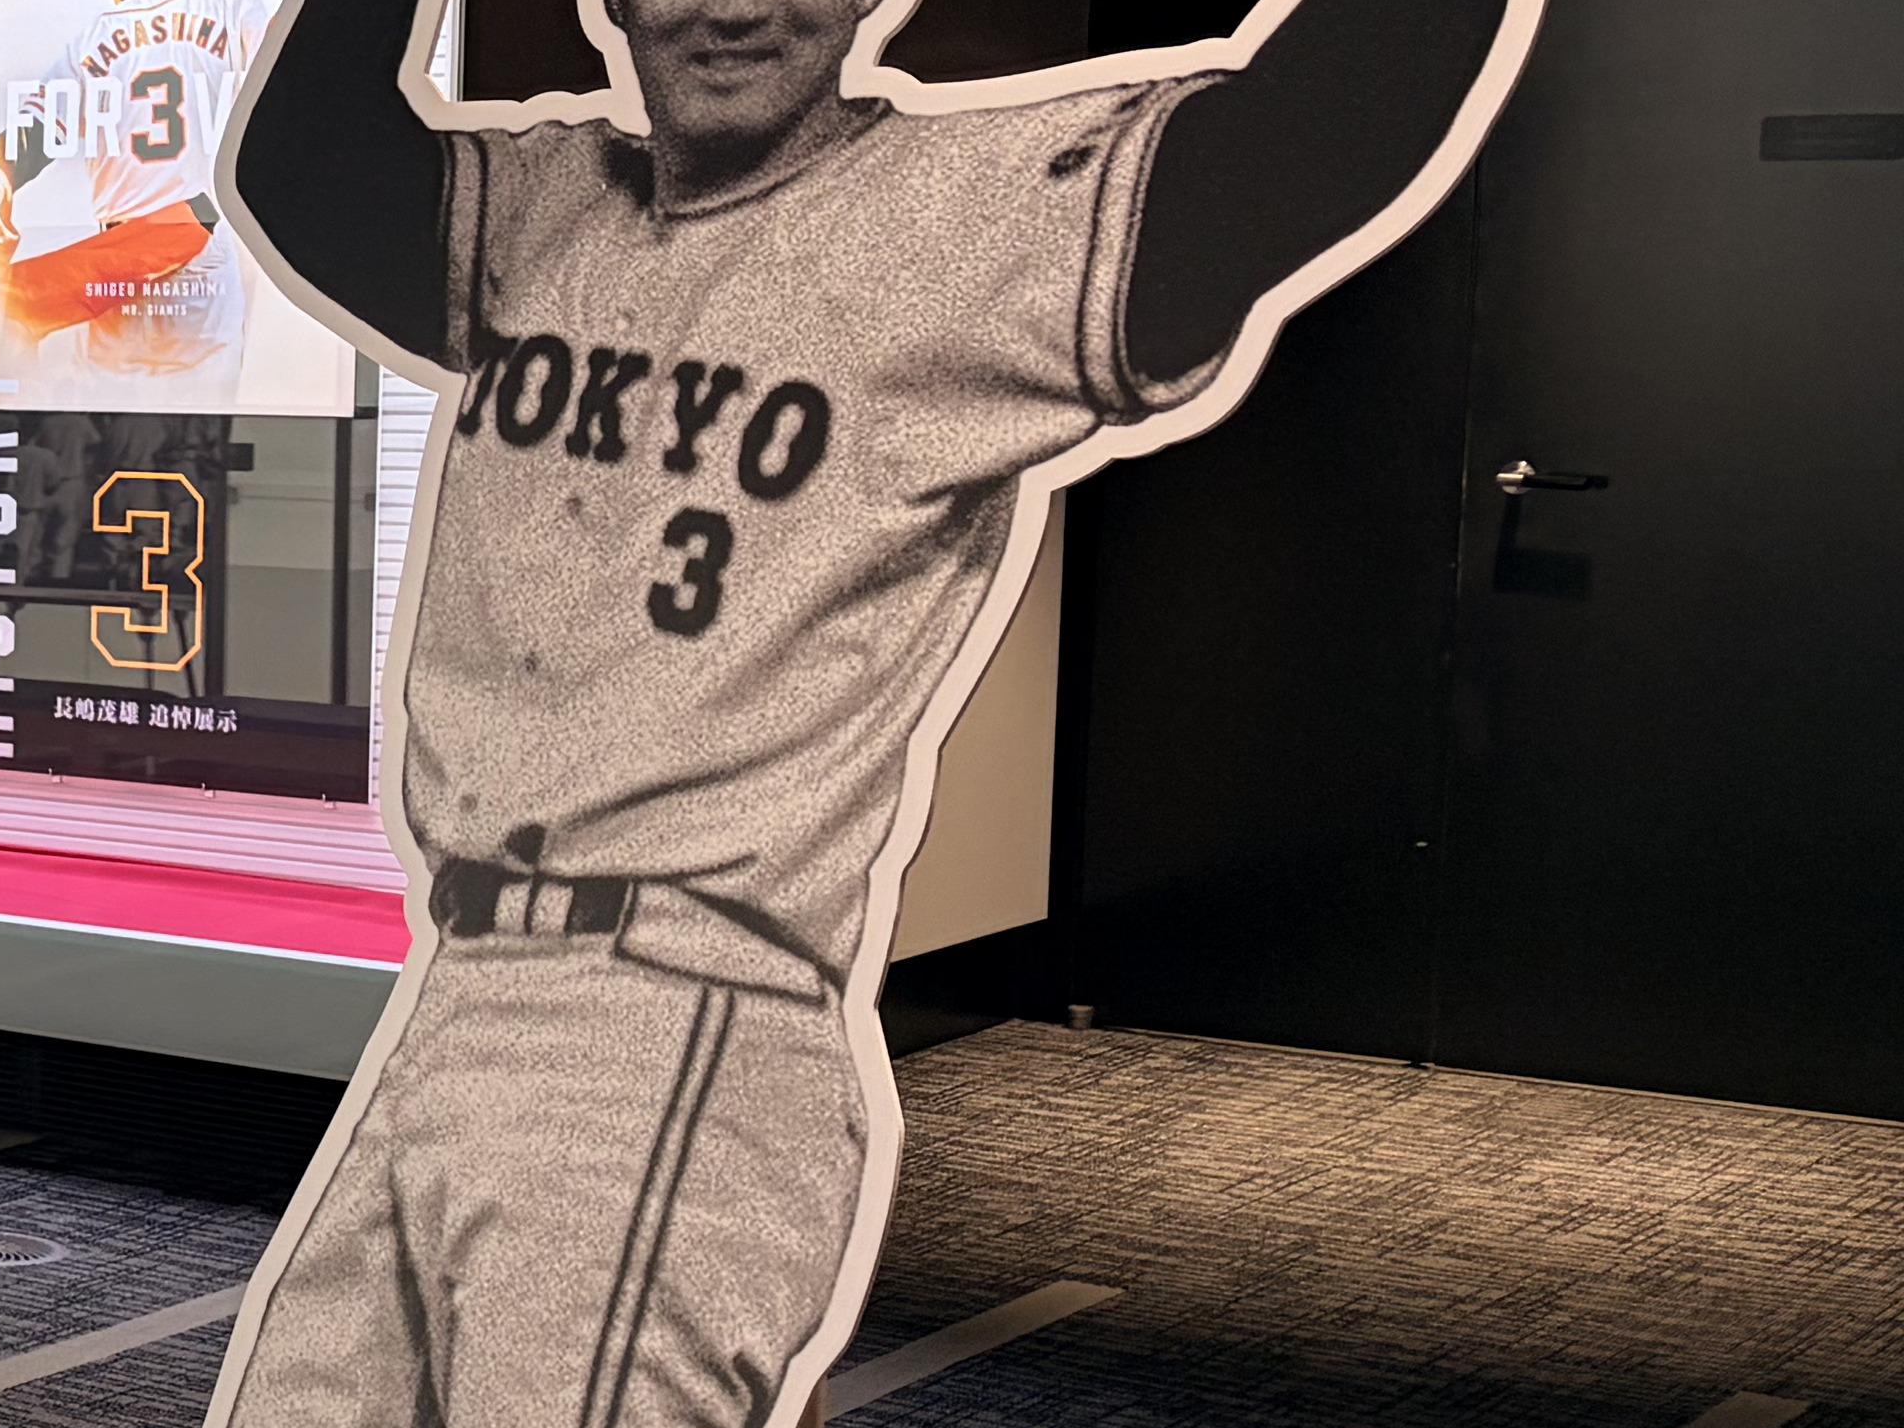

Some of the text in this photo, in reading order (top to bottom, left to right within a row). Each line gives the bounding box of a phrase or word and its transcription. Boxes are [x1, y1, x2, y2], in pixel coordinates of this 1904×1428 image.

[80, 12, 229, 78] NAGASHIMA
[85, 281, 228, 297] SHIGEO NAGASHIMA
[147, 305, 189, 317] GIANTS
[90, 471, 205, 672] 3
[646, 507, 734, 637] 3
[53, 695, 238, 733] 長嶋茂雄 追悼展示
